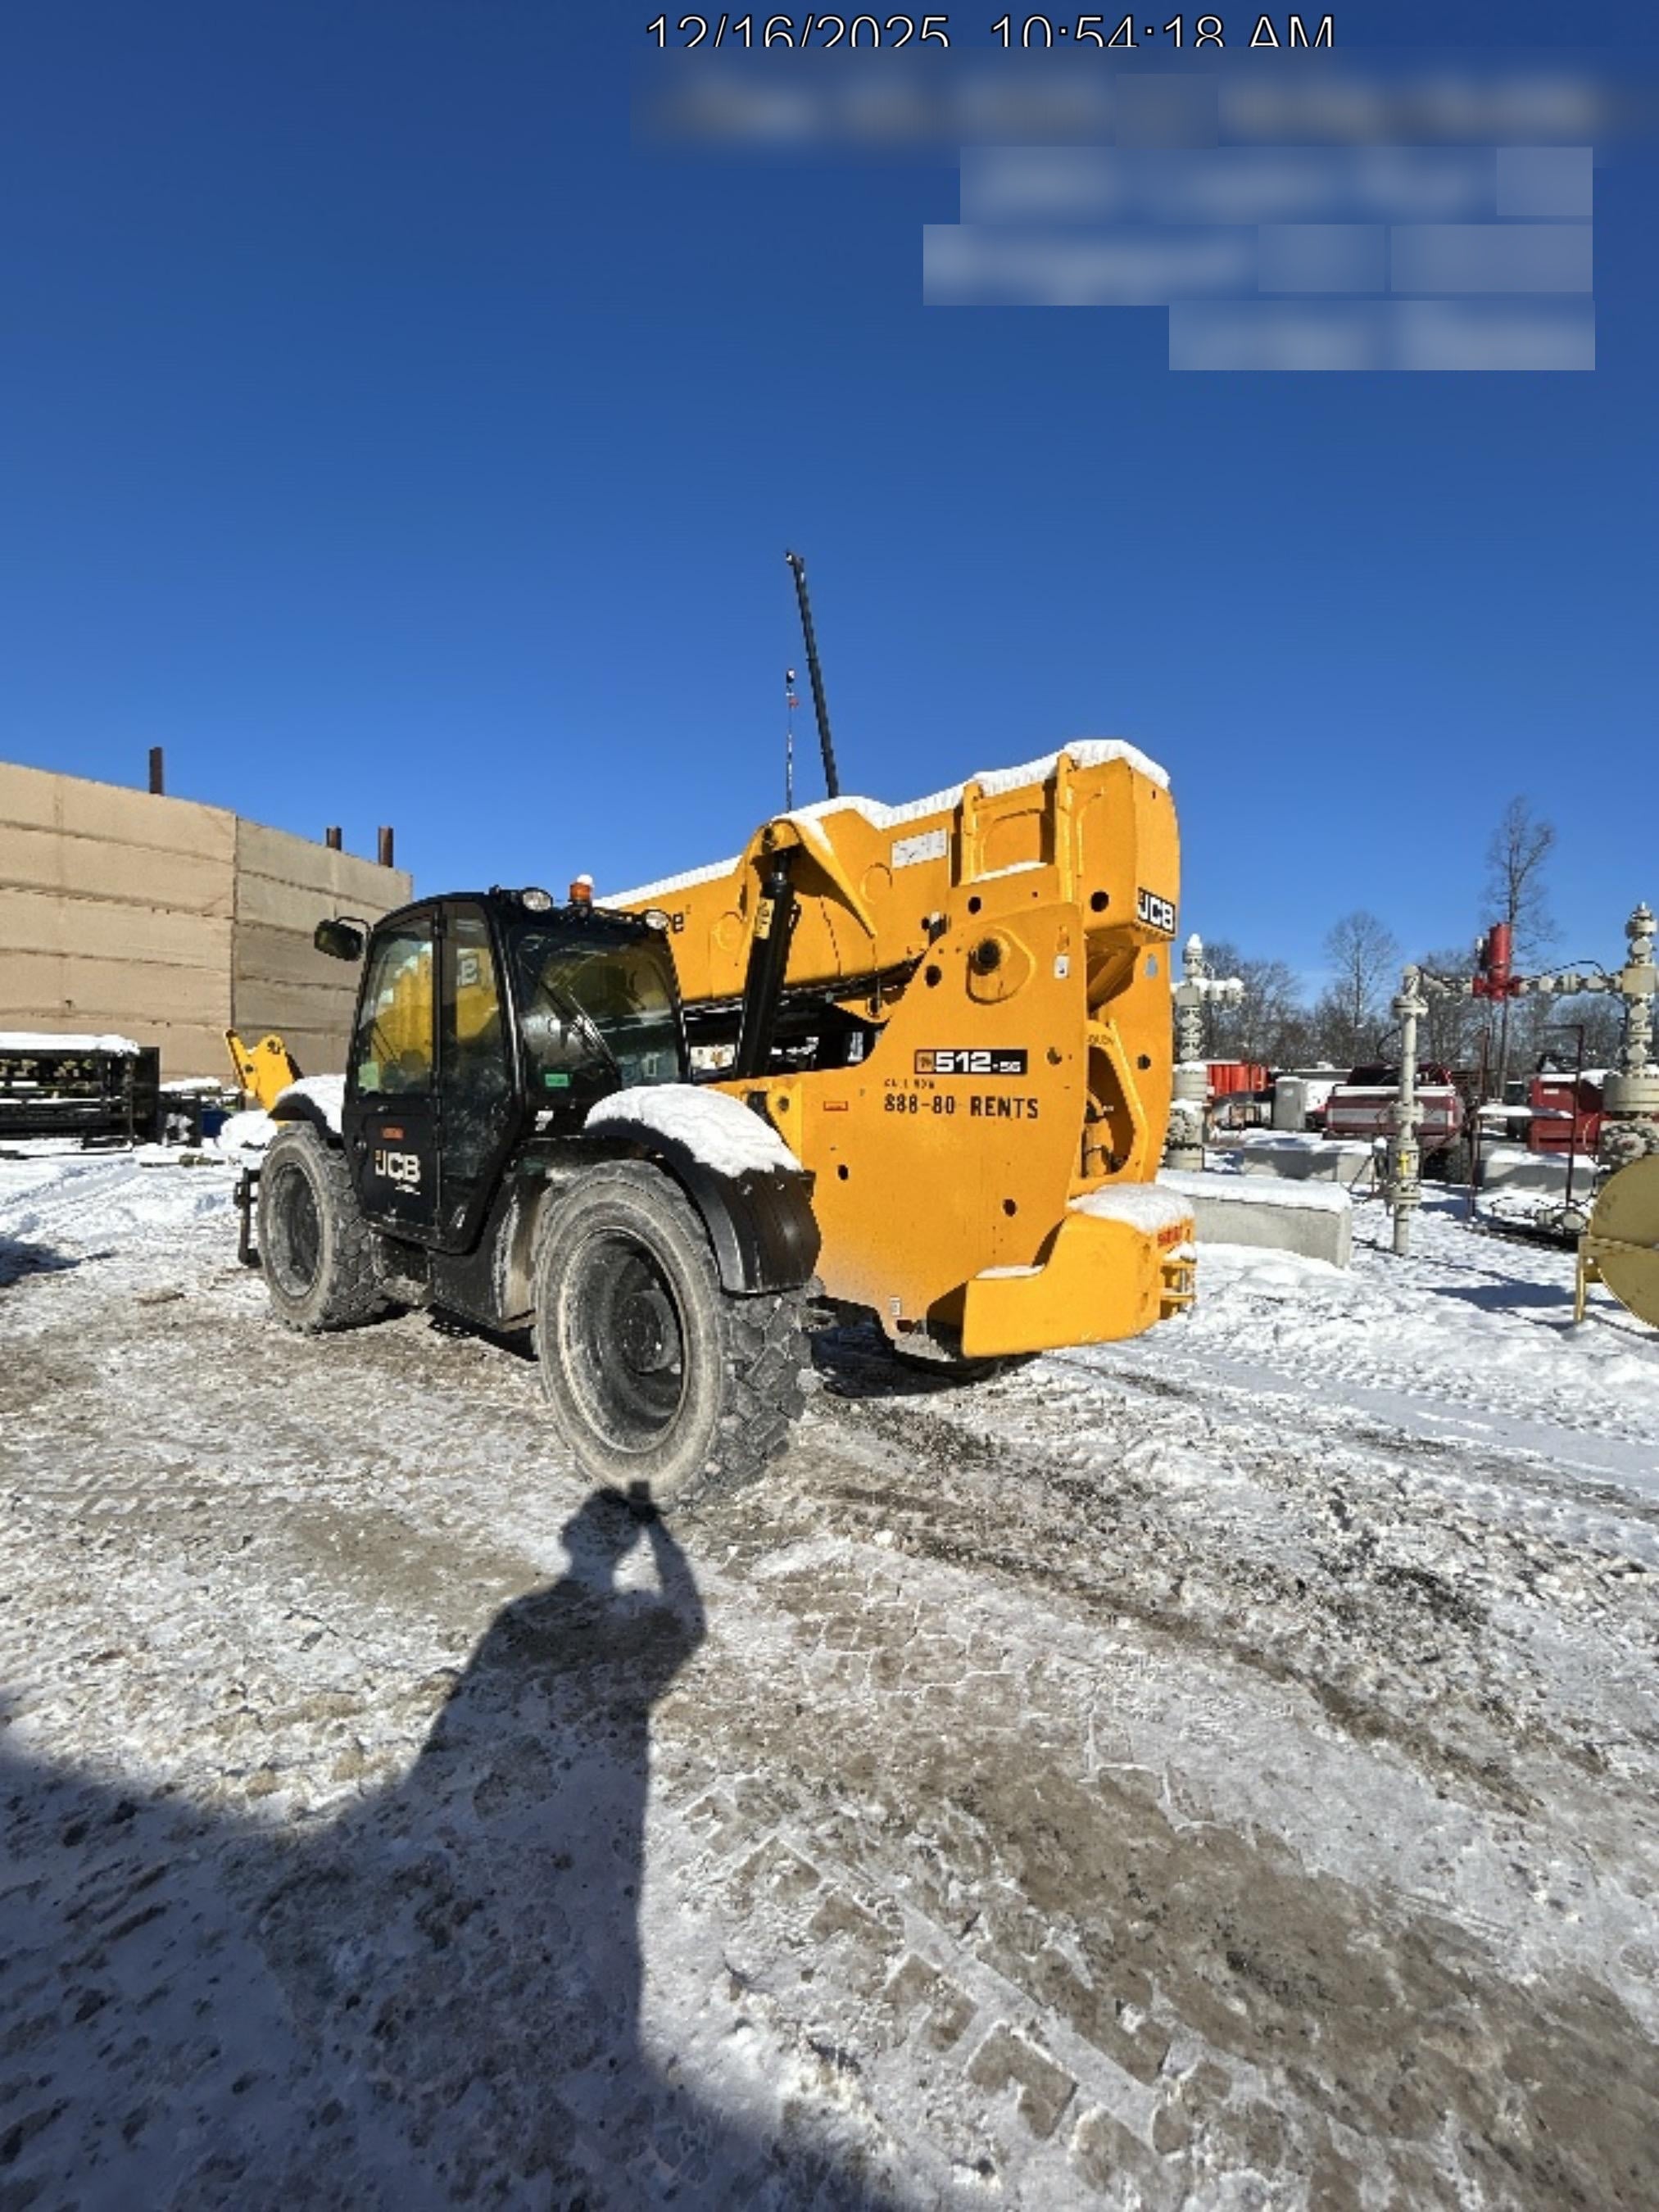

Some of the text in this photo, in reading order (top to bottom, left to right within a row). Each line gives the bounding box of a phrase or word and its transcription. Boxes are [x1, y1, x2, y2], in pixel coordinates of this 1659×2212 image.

[1137, 890, 1174, 932] JCB
[970, 1095, 1039, 1120] RENTS
[374, 1149, 421, 1183] JCB
